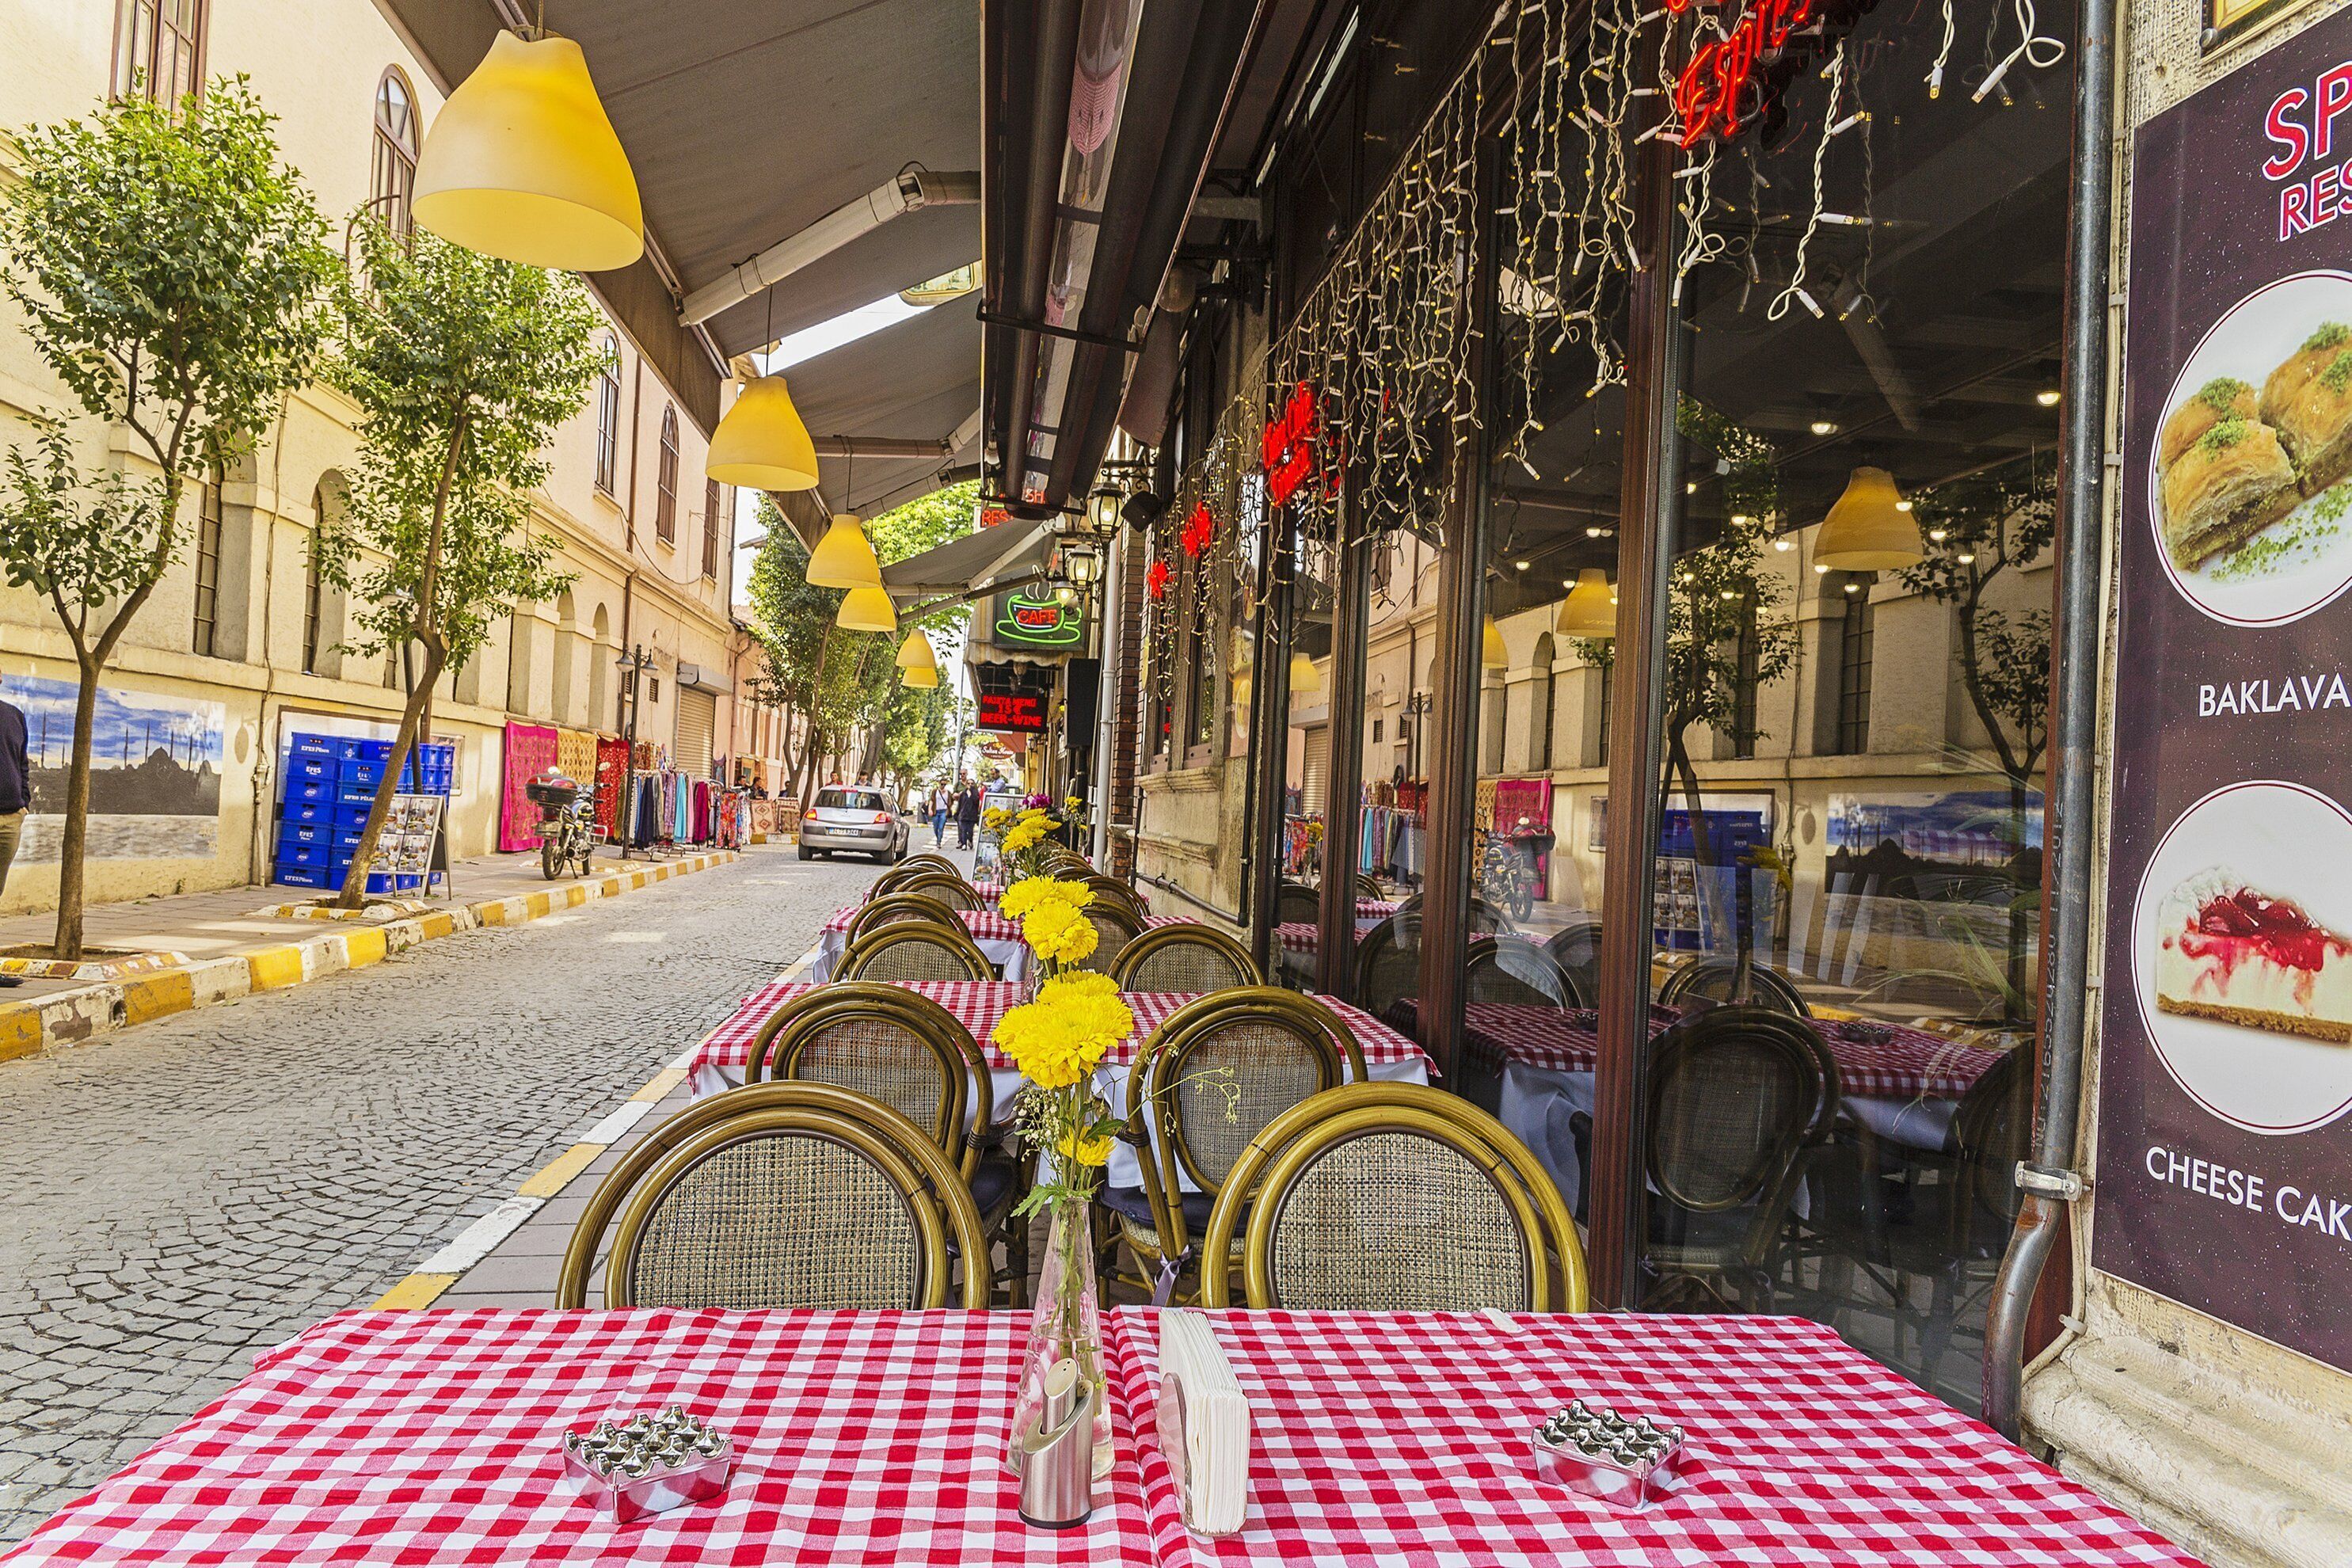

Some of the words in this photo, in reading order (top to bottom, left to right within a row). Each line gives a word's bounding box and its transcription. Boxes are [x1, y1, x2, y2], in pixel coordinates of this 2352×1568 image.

[2263, 60, 2352, 181] SP
[1018, 609, 1057, 624] CAFE
[2198, 672, 2351, 717] BAKLAVA
[980, 712, 1042, 727] BEER-WINE
[2145, 1146, 2264, 1213] CHEESE
[2274, 1186, 2352, 1242] CAK
